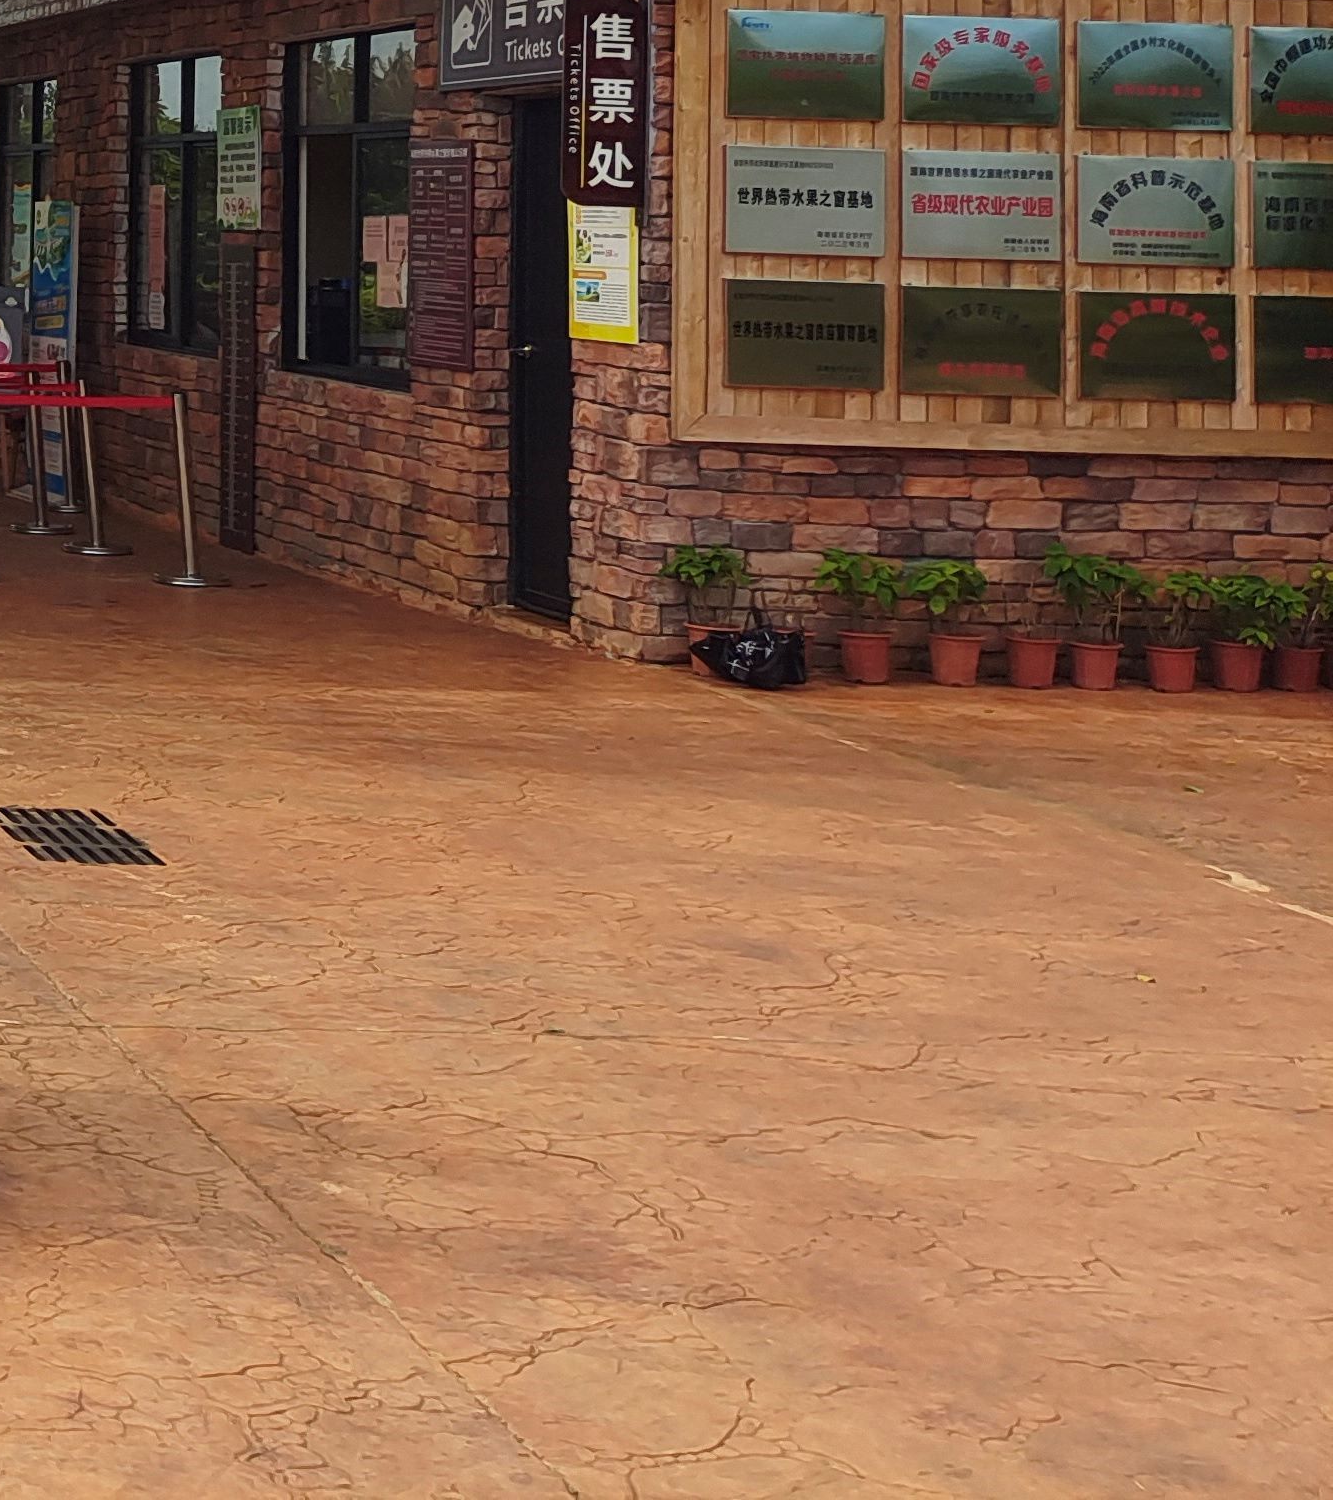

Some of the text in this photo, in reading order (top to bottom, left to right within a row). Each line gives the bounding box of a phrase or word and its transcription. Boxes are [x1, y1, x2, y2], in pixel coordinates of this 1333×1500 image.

[504, 38, 552, 63] Tickets
[912, 26, 1052, 93] 国家级专家服务基地
[587, 12, 635, 189] 售票处
[737, 186, 874, 209] 世界热带水果之窗基地
[911, 193, 1054, 218] 省级现代农业产业园
[1089, 169, 1225, 232] 海南省科普示范基地
